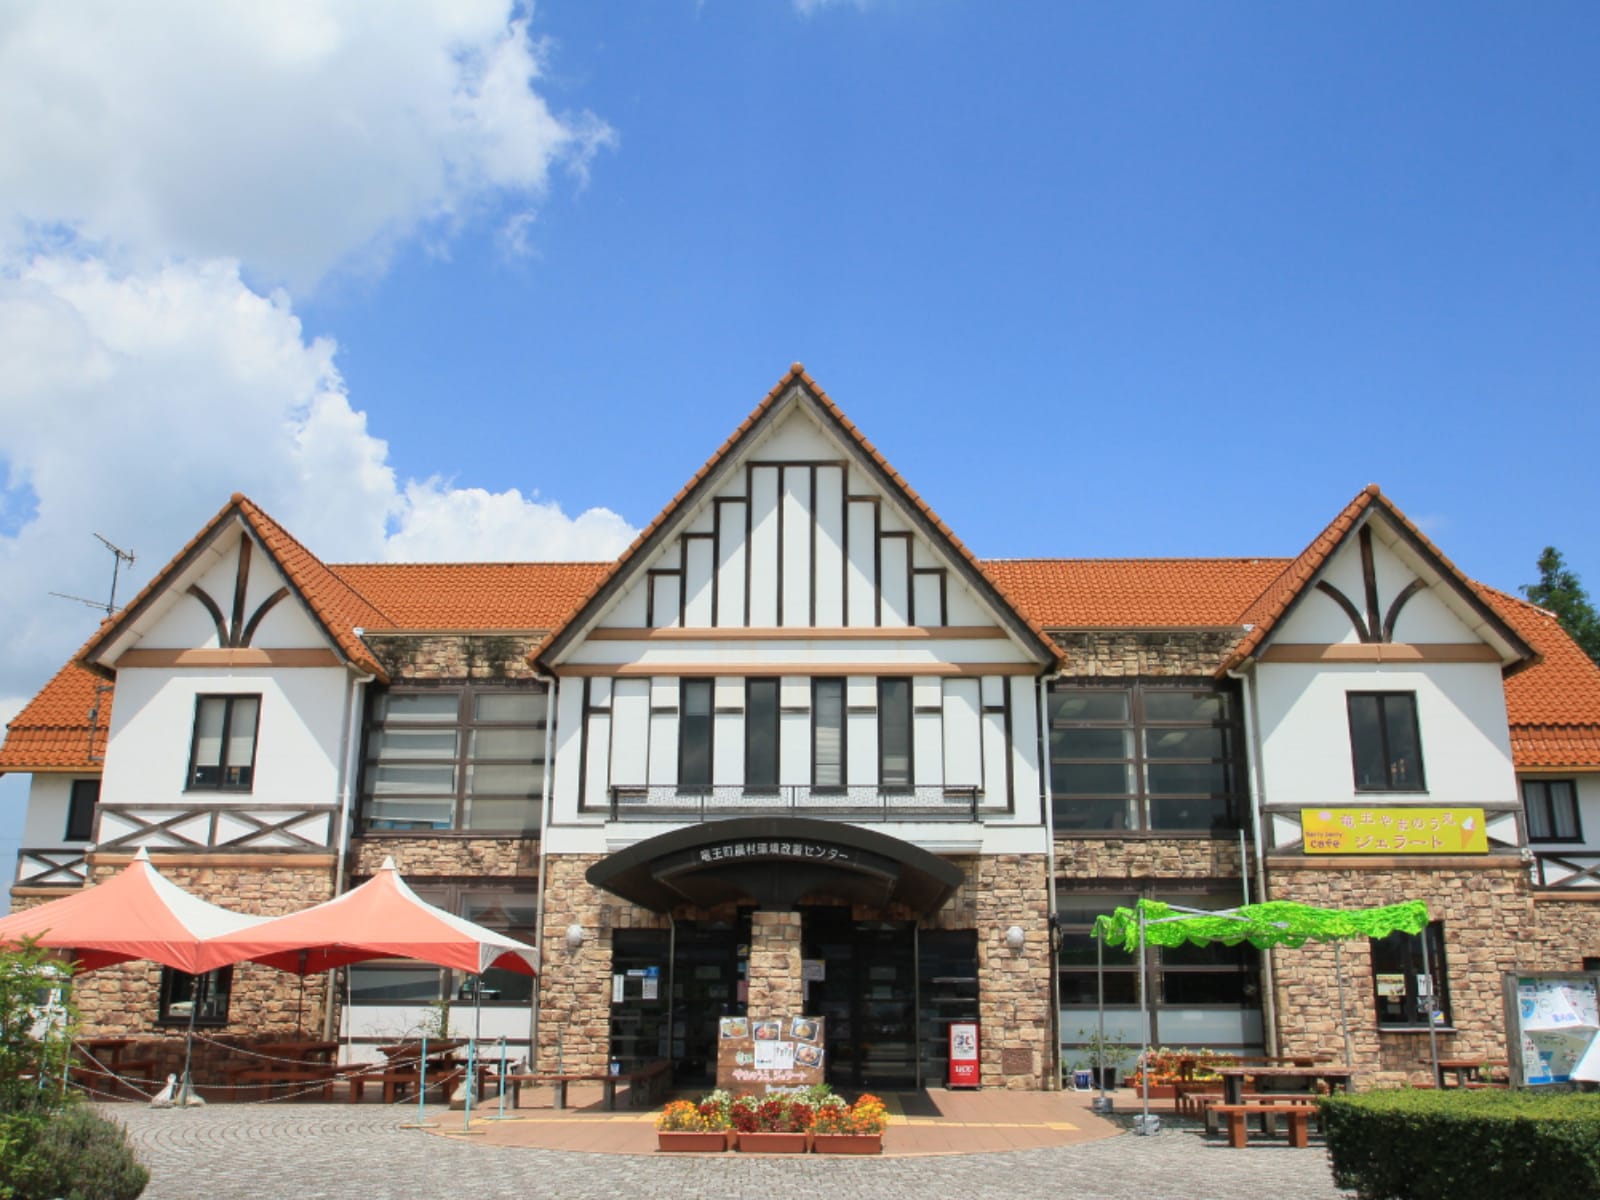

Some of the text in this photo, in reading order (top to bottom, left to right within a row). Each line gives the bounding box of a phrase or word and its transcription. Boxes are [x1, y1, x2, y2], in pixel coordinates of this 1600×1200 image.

[1310, 838, 1341, 849] cafe
[1354, 834, 1445, 850] ジェラート
